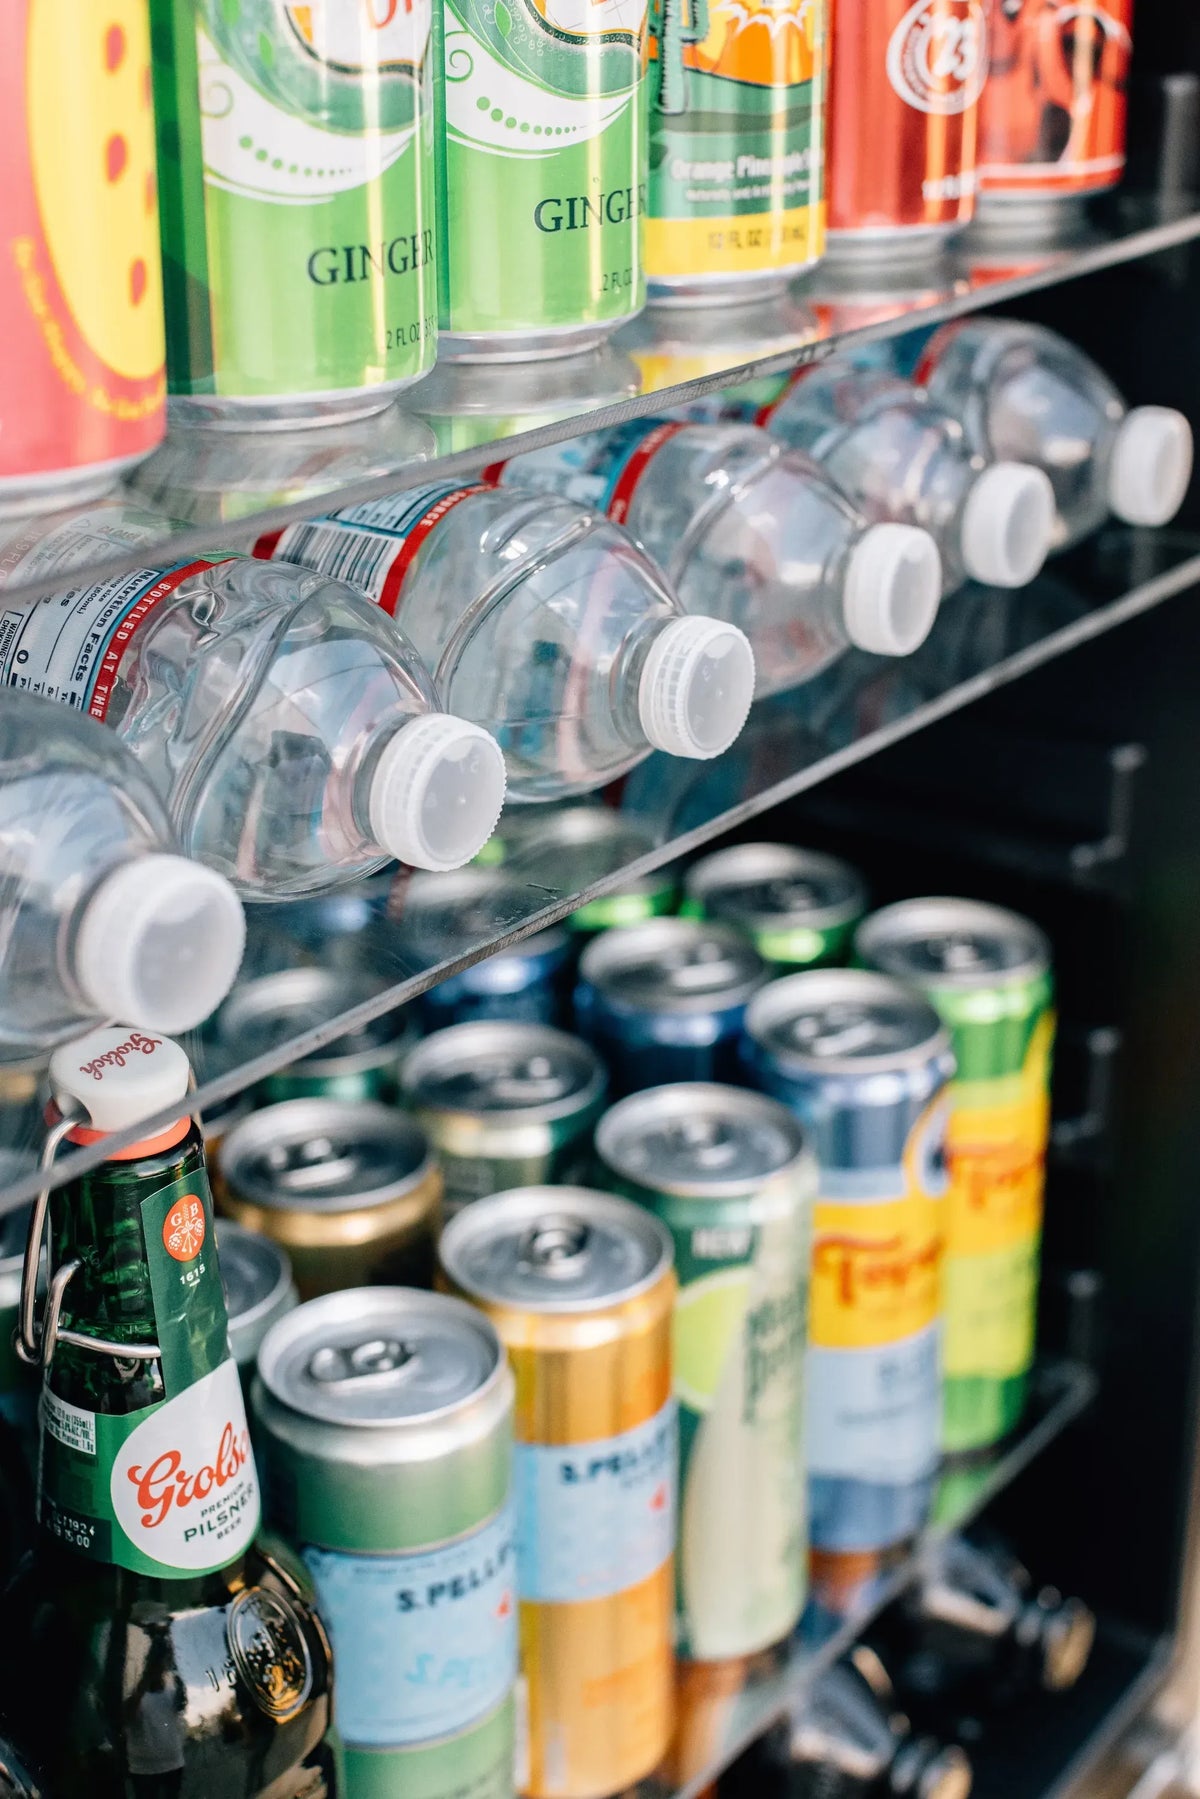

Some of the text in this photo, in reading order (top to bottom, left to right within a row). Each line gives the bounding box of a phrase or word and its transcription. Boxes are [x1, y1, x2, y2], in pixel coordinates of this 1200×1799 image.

[670, 159, 734, 182] Orange
[534, 184, 647, 232] GINGER
[307, 229, 433, 286] GINGER
[396, 327, 407, 347] FL
[75, 569, 156, 682] Nutrition Facts
[89, 582, 171, 718] BOTTLED AT THE
[79, 1033, 163, 1081] Grolsch
[170, 1202, 199, 1227] G B
[179, 1263, 206, 1285] 1615
[184, 1483, 255, 1543] PILSNER
[201, 1481, 244, 1518] PREMIUM
[217, 1517, 242, 1540] BEER
